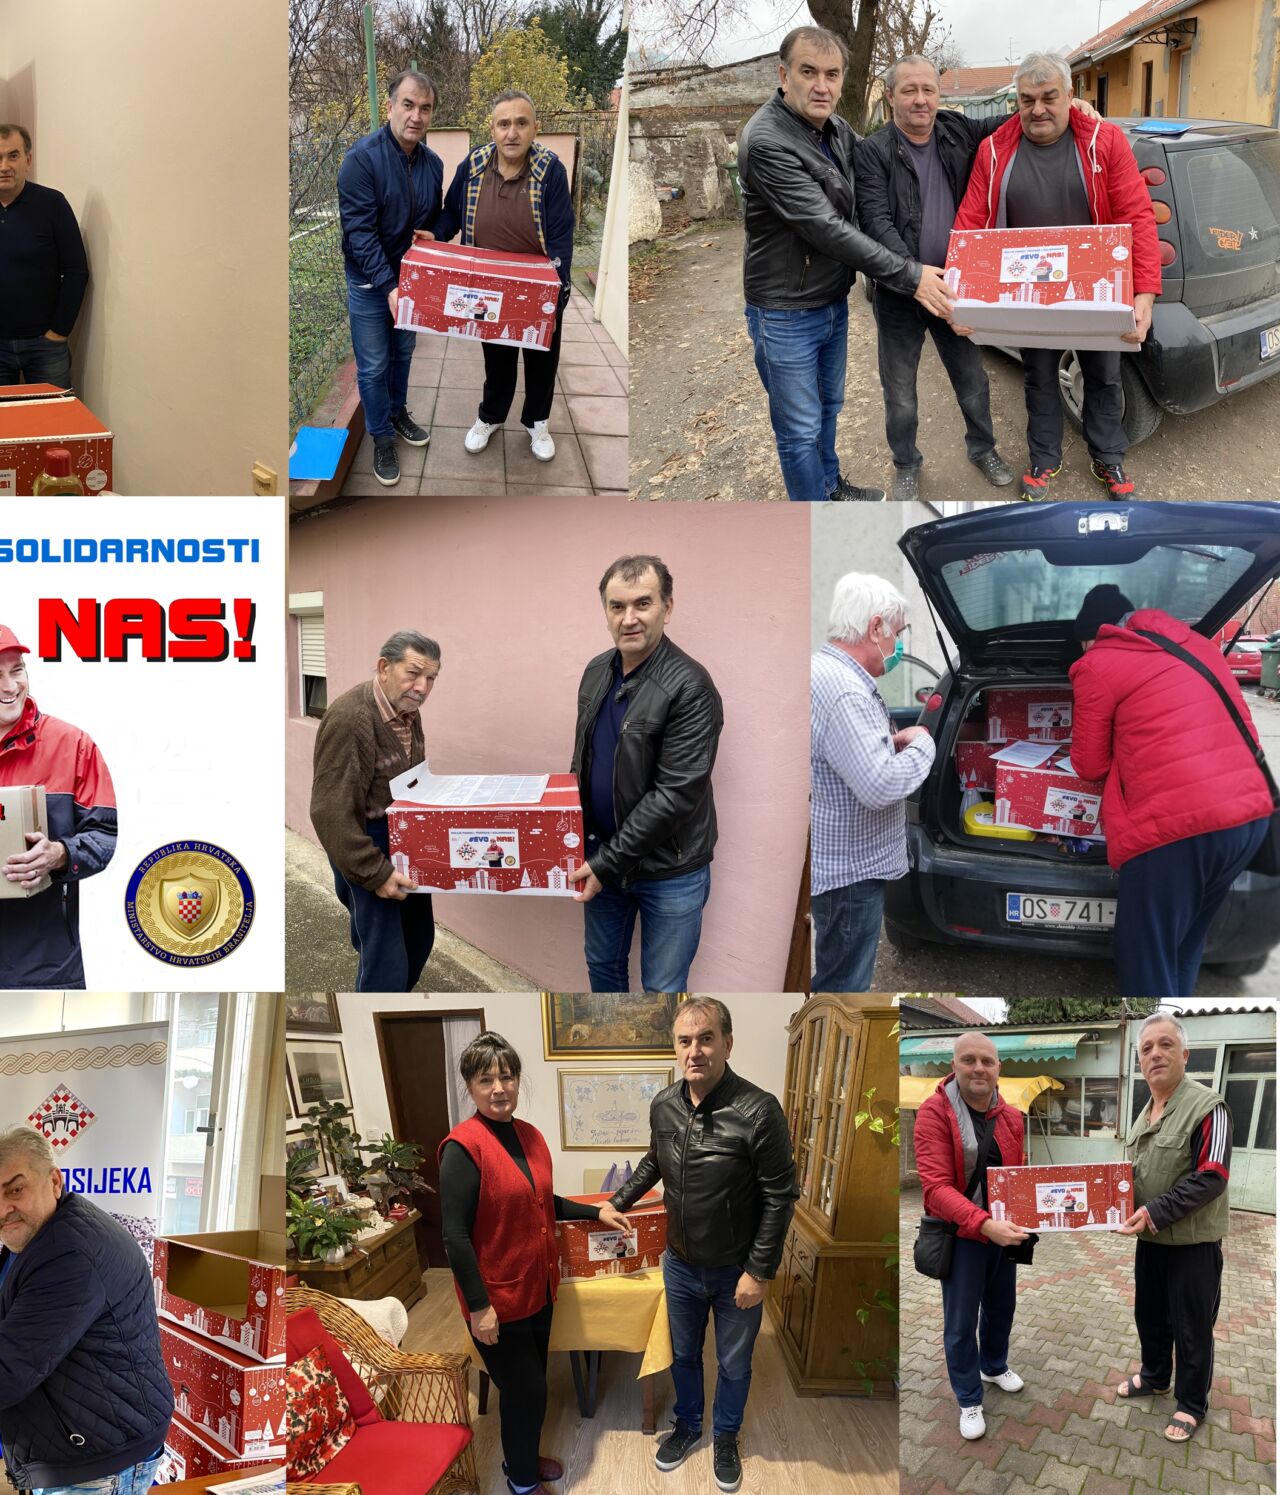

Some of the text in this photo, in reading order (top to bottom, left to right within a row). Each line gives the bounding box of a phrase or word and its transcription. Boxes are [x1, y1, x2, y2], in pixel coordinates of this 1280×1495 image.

[38, 598, 257, 662] NAS!
[138, 842, 241, 874] REPUBLIKA HRVATSKA
[127, 901, 253, 965] MINISTARSTVO HRVATSKIH BRANITELJA
[1022, 898, 1048, 920] OS
